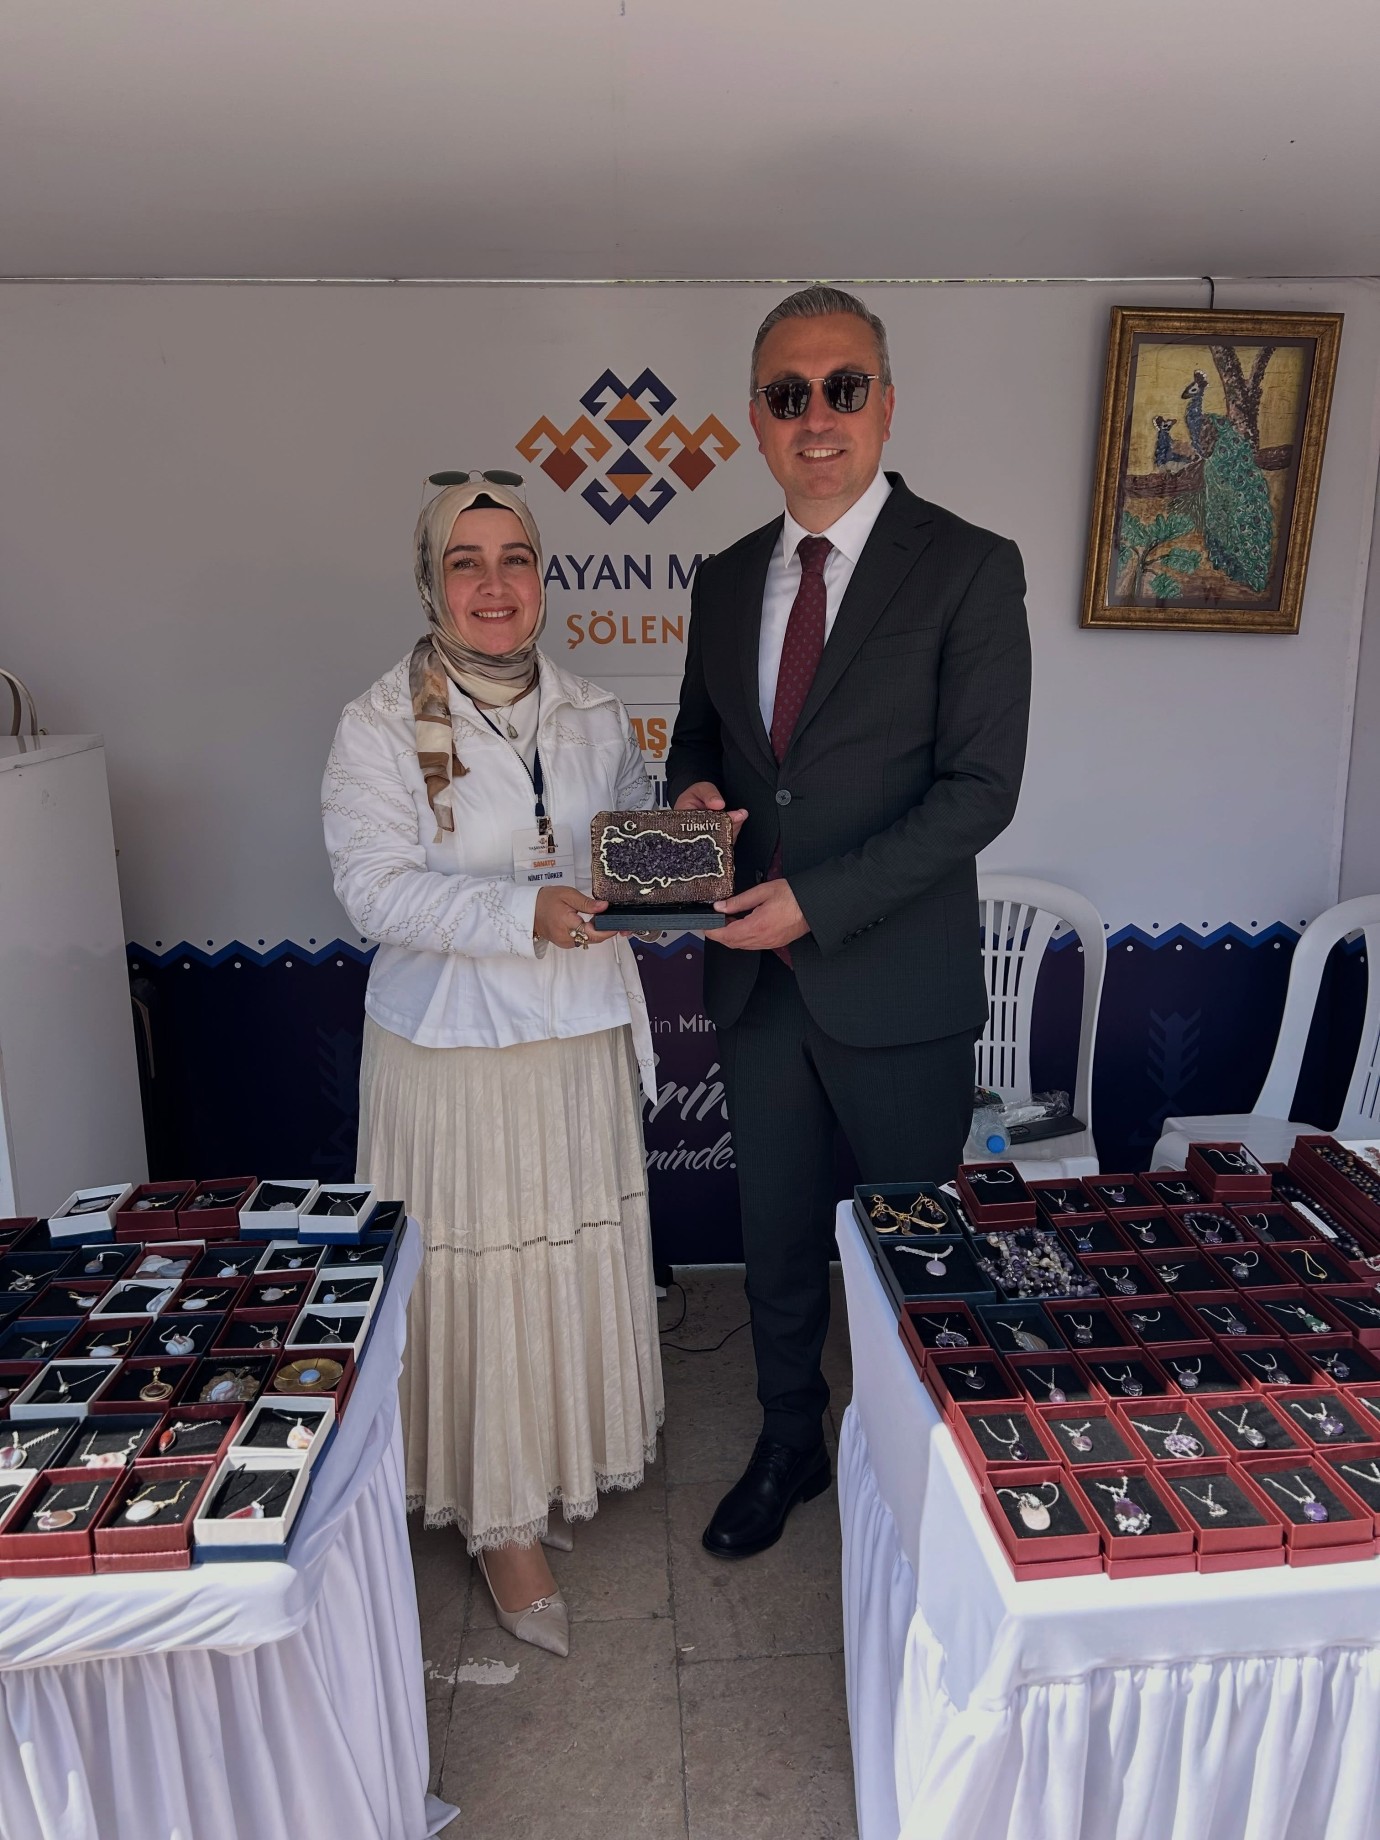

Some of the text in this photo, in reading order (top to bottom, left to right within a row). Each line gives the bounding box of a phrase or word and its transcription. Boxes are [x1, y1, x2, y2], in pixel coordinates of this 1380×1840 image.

[668, 553, 716, 590] M
[565, 610, 684, 650] ŞÖLEN
[680, 819, 721, 832] TÜRKİYE
[533, 859, 556, 868] SANATÇI
[679, 1013, 717, 1033] Mir
